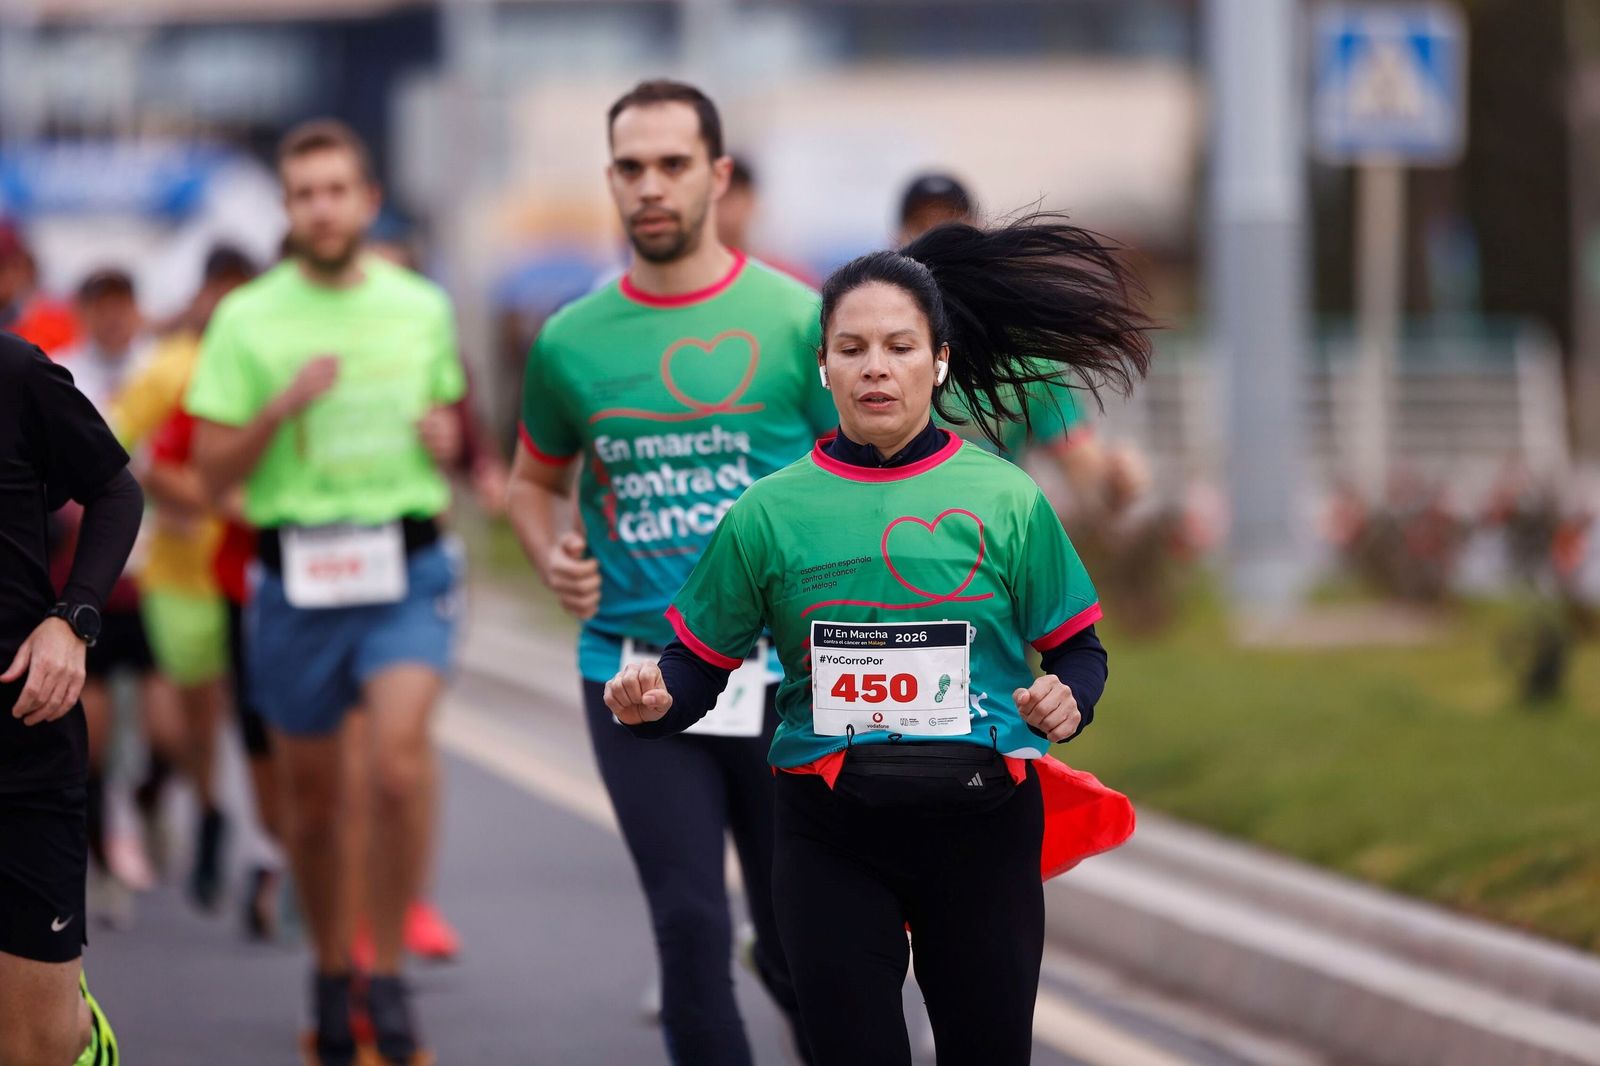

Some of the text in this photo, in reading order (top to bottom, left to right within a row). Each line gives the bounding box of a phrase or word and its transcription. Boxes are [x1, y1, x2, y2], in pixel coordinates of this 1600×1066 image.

[595, 424, 750, 462] En marcha
[612, 463, 715, 499] contra
[800, 555, 871, 575] asociación española
[801, 573, 823, 584] contra
[832, 567, 857, 577] cáncer
[812, 580, 837, 590] Málaga
[823, 628, 928, 643] IV En Marcha 2026
[819, 655, 884, 666] #YoCorroPor
[831, 673, 918, 704] 450
